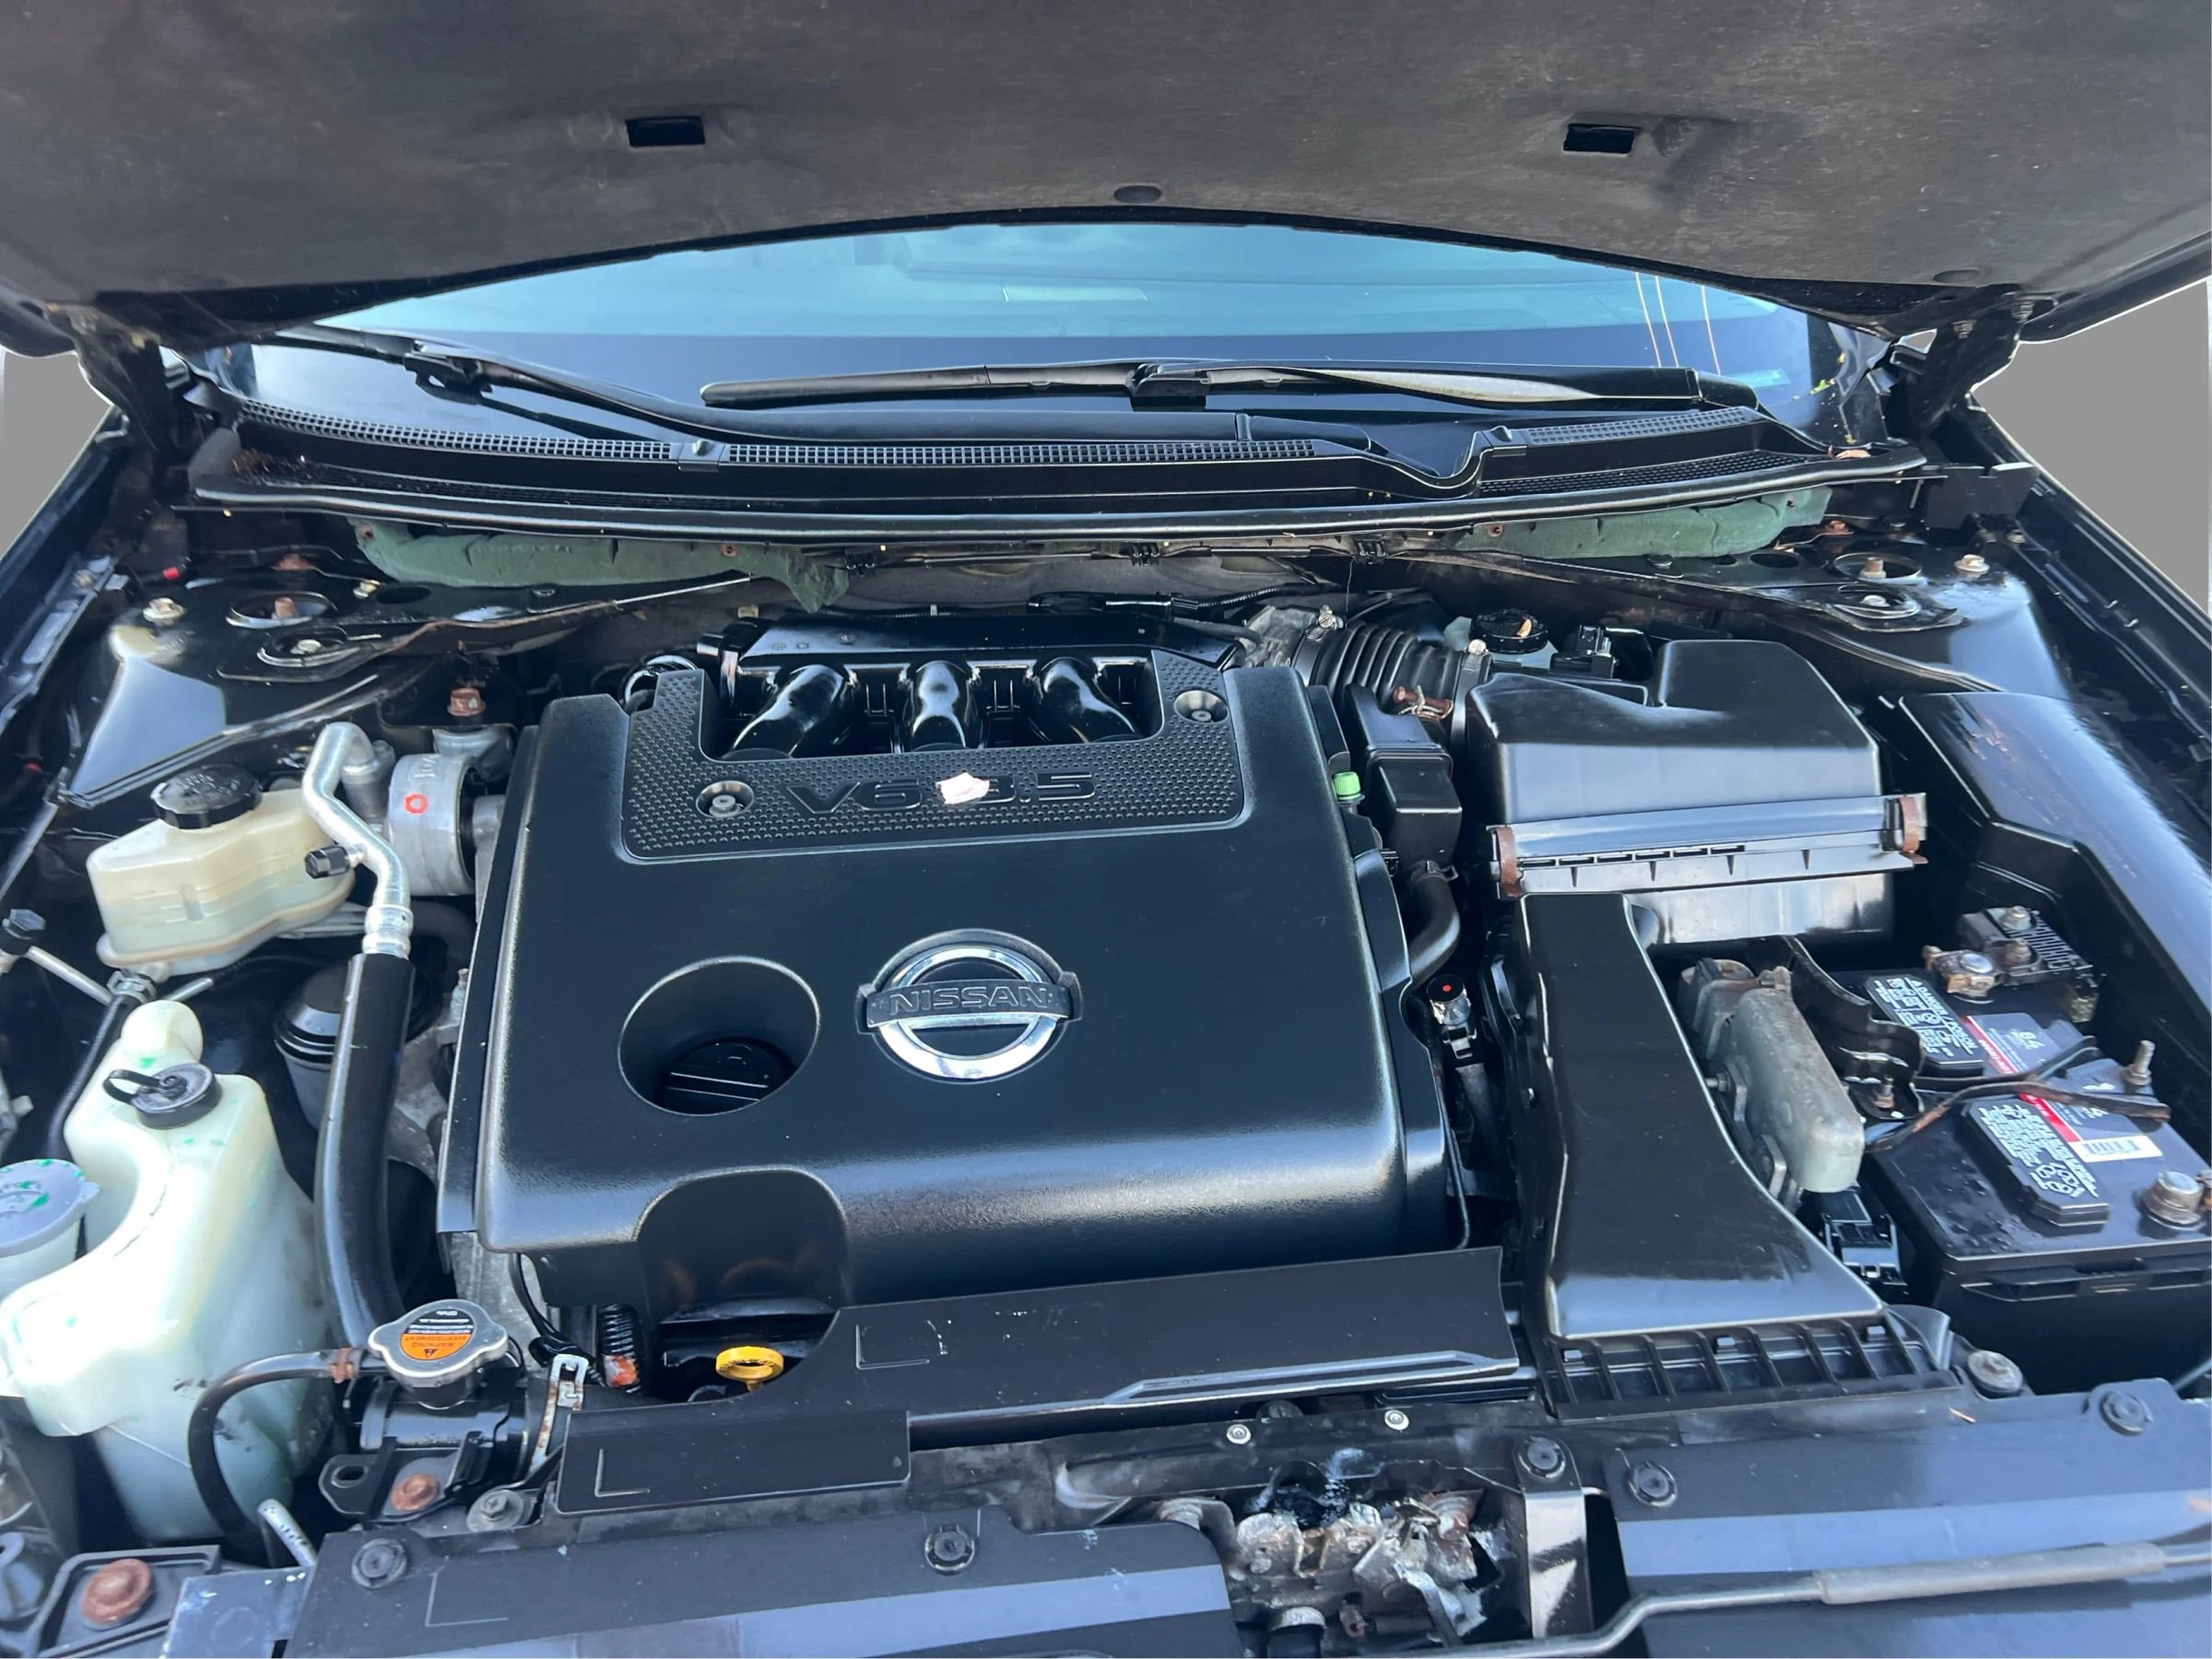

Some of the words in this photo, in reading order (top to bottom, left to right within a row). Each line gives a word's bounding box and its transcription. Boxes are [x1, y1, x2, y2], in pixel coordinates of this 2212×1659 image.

[786, 779, 923, 815] V6
[888, 985, 1049, 1016] NISSAN
[1918, 985, 1949, 1016] DANGER
[1947, 1020, 1979, 1049] POISON
